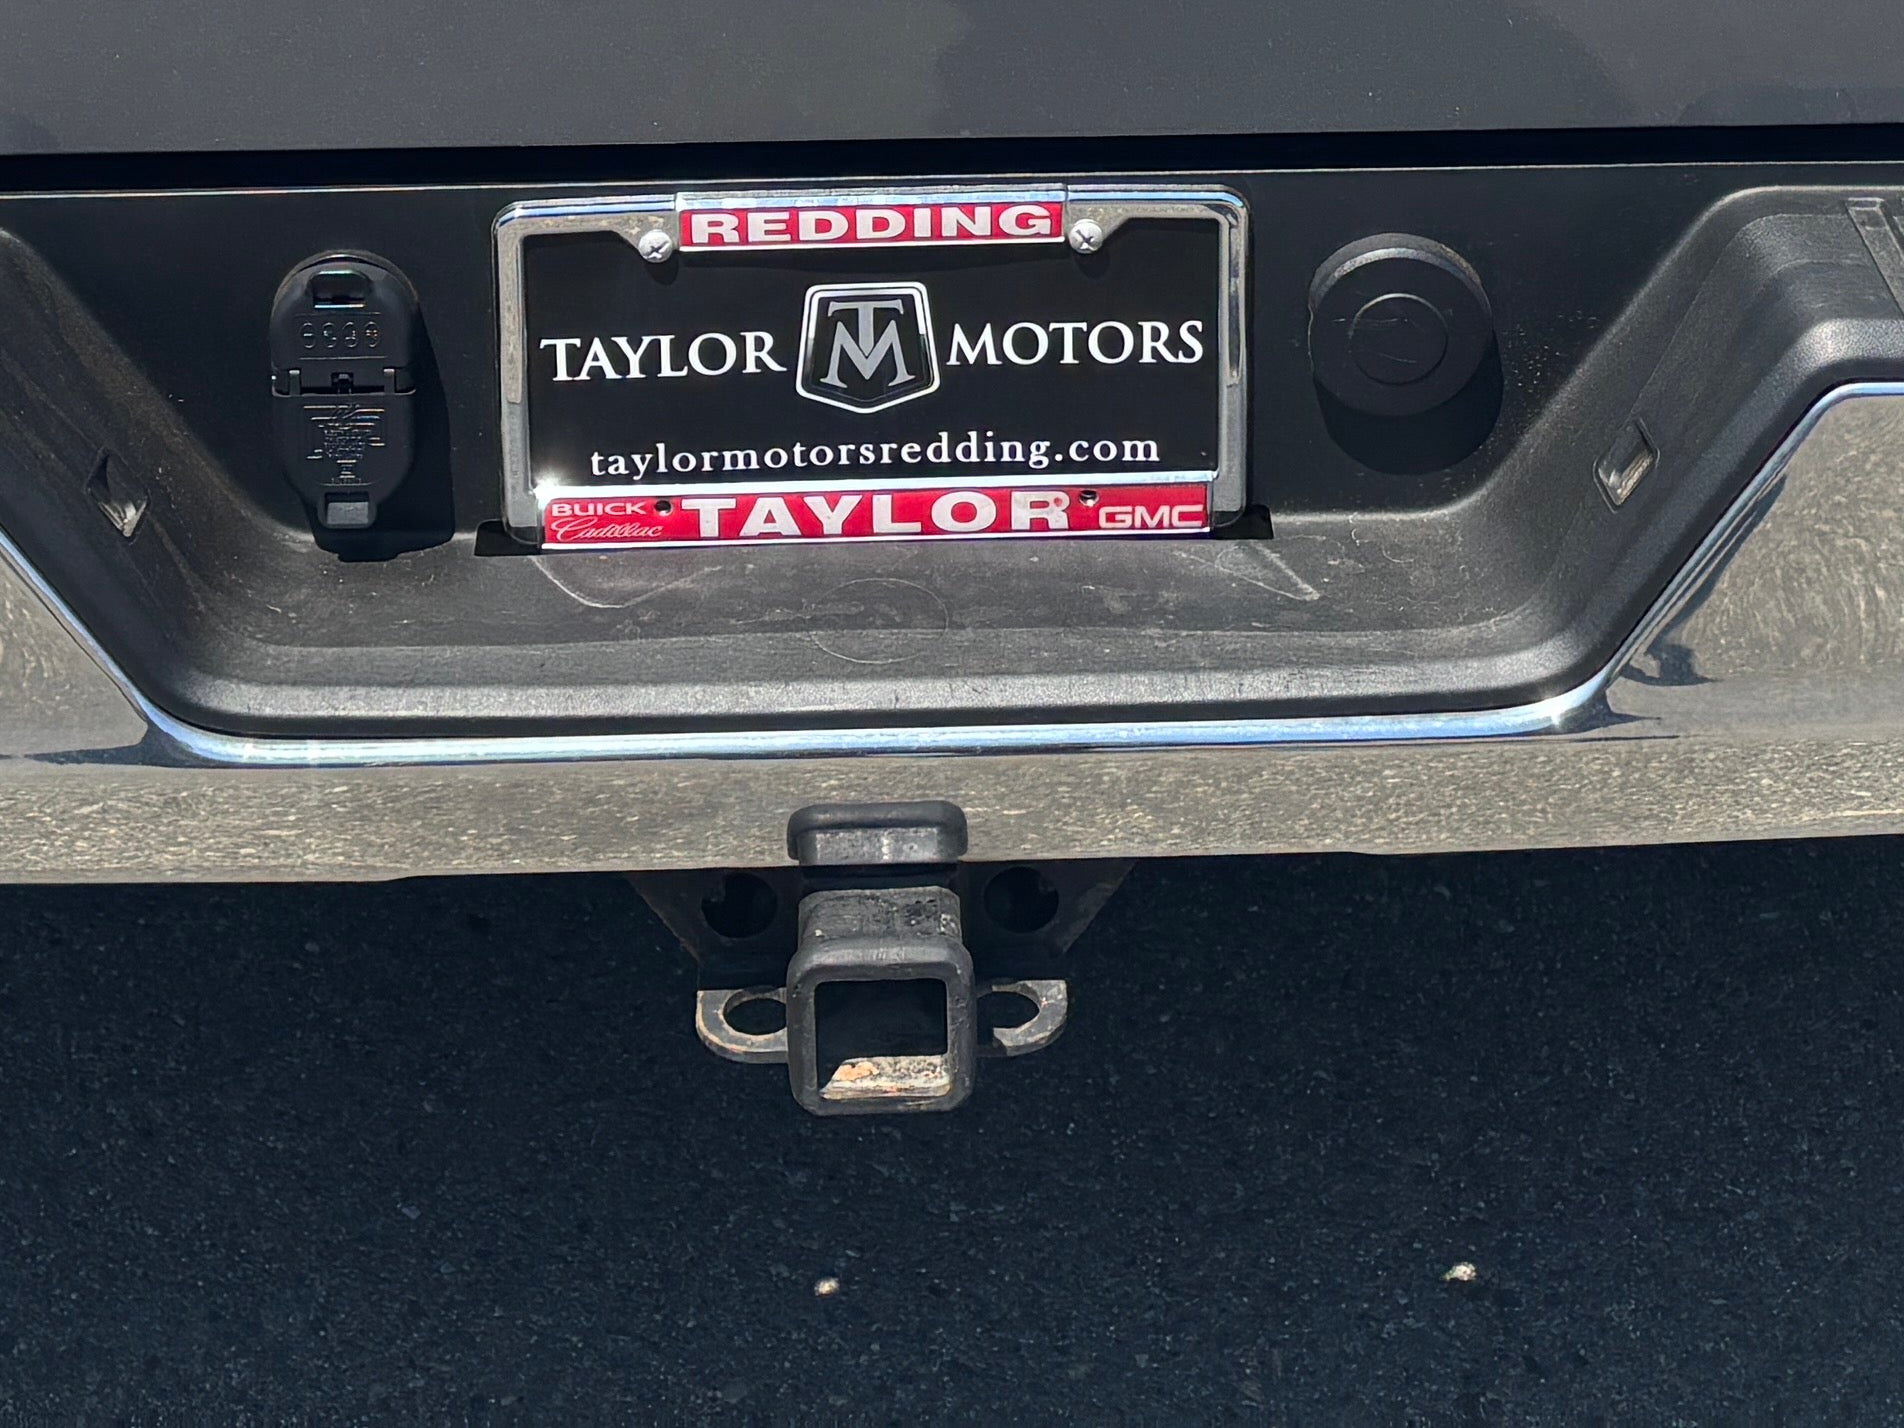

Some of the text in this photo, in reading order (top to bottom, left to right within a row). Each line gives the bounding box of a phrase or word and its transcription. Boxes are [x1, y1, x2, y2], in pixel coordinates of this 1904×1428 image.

[690, 204, 1053, 245] REDDING
[539, 331, 788, 382] TAYLOR
[946, 319, 1204, 366] MOTORS
[591, 430, 1160, 481] taylormotorsredding.com
[550, 516, 664, 542] Cadillac
[551, 501, 647, 517] BUICK
[681, 490, 1071, 539] TAYLOR
[1098, 504, 1205, 530] GMC
